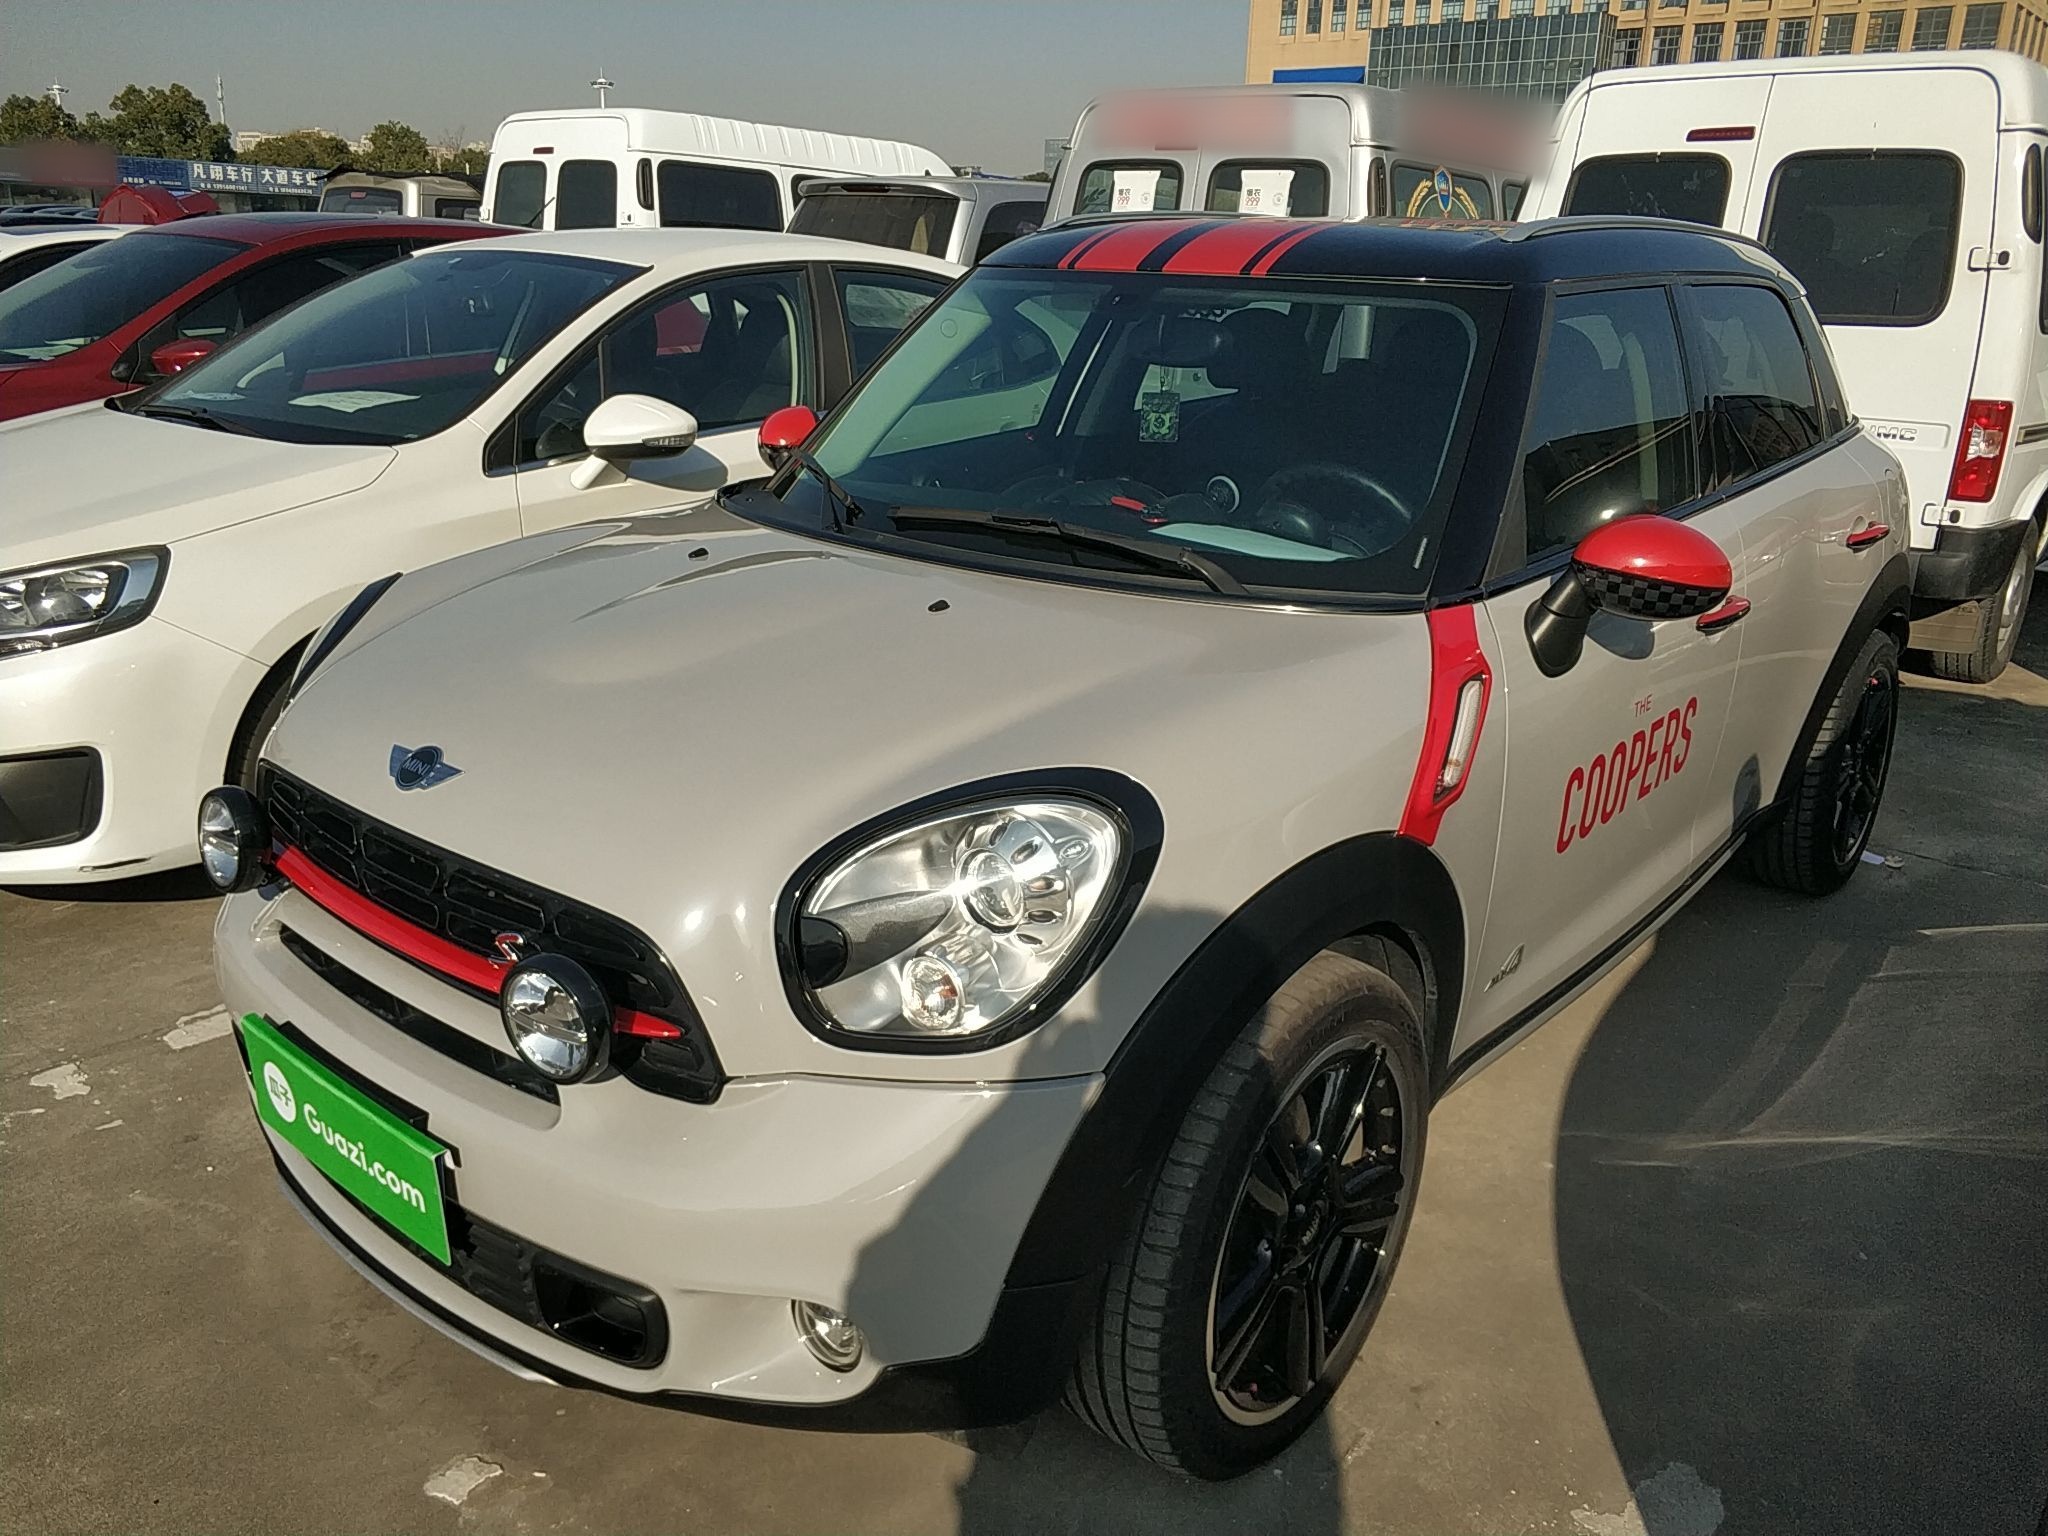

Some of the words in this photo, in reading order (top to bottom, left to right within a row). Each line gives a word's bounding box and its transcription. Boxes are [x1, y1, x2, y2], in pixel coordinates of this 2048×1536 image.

[260, 168, 318, 187] 大道车业
[1634, 693, 1653, 718] THE
[402, 757, 432, 776] MINI
[1556, 696, 1698, 854] COOPERS
[303, 1103, 426, 1213] Guazi.com
